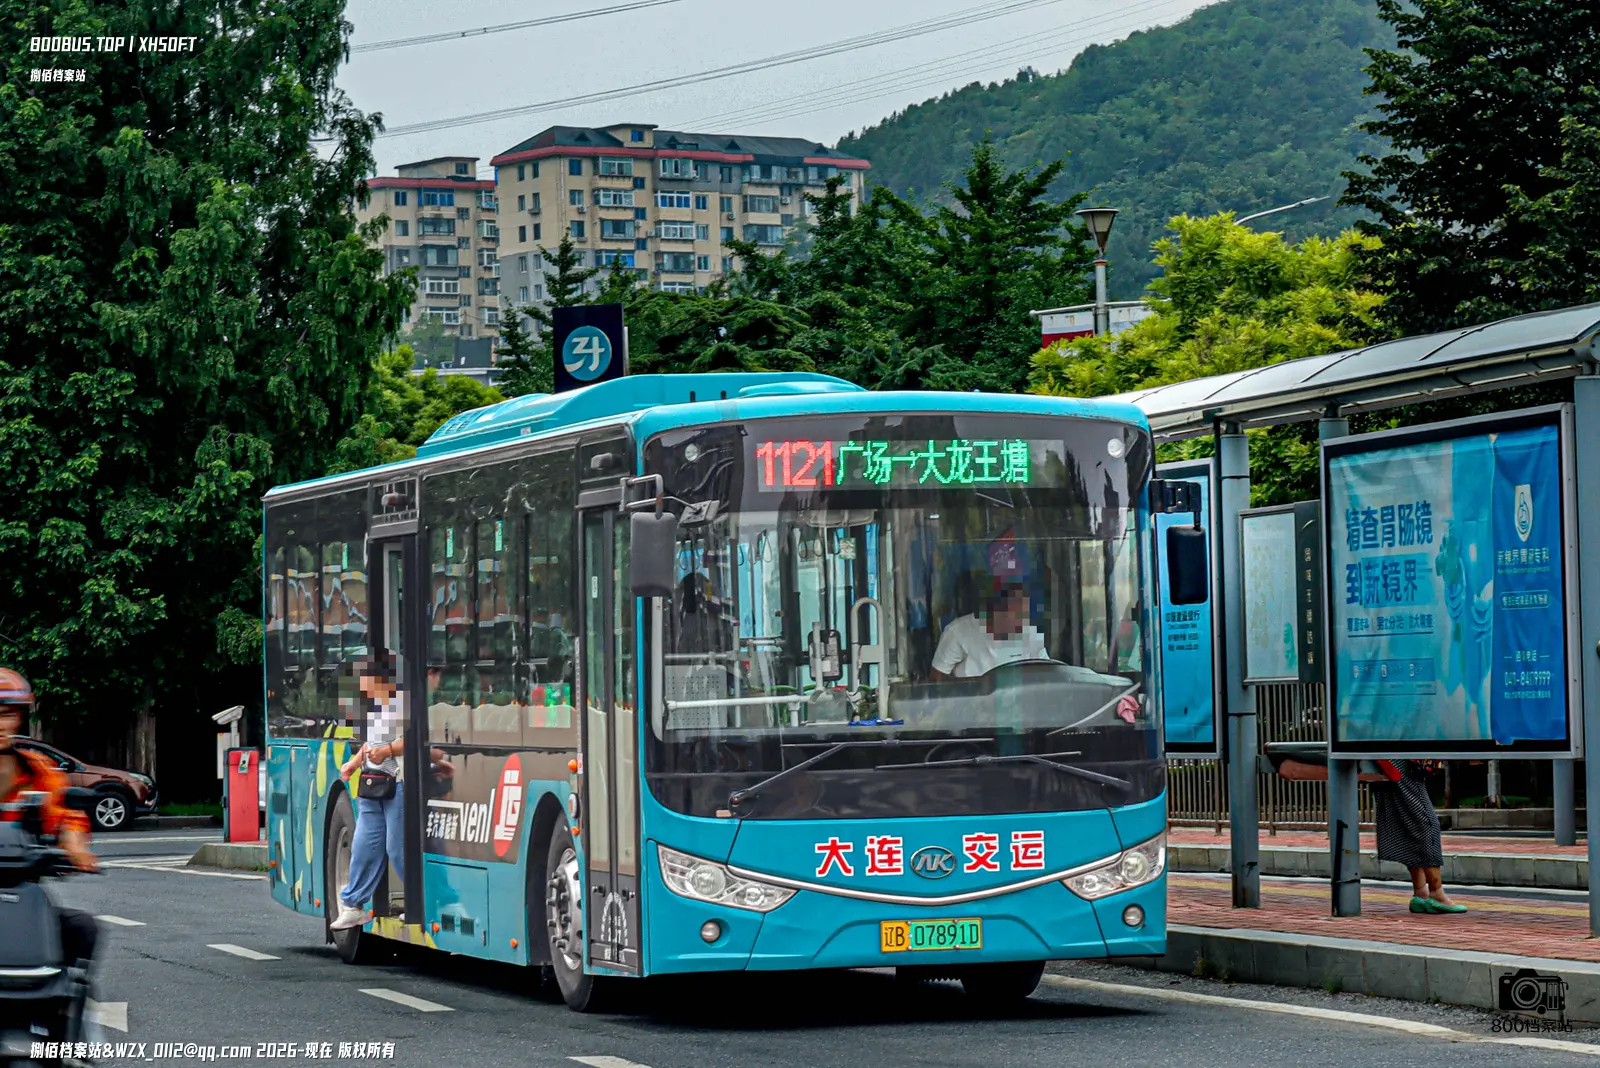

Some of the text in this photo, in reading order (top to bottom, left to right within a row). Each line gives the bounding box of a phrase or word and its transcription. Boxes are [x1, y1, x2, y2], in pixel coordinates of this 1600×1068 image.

[756, 440, 834, 487] 1121
[1345, 500, 1434, 552] 精查胃肠镜
[1345, 559, 1418, 606] 到新镜界
